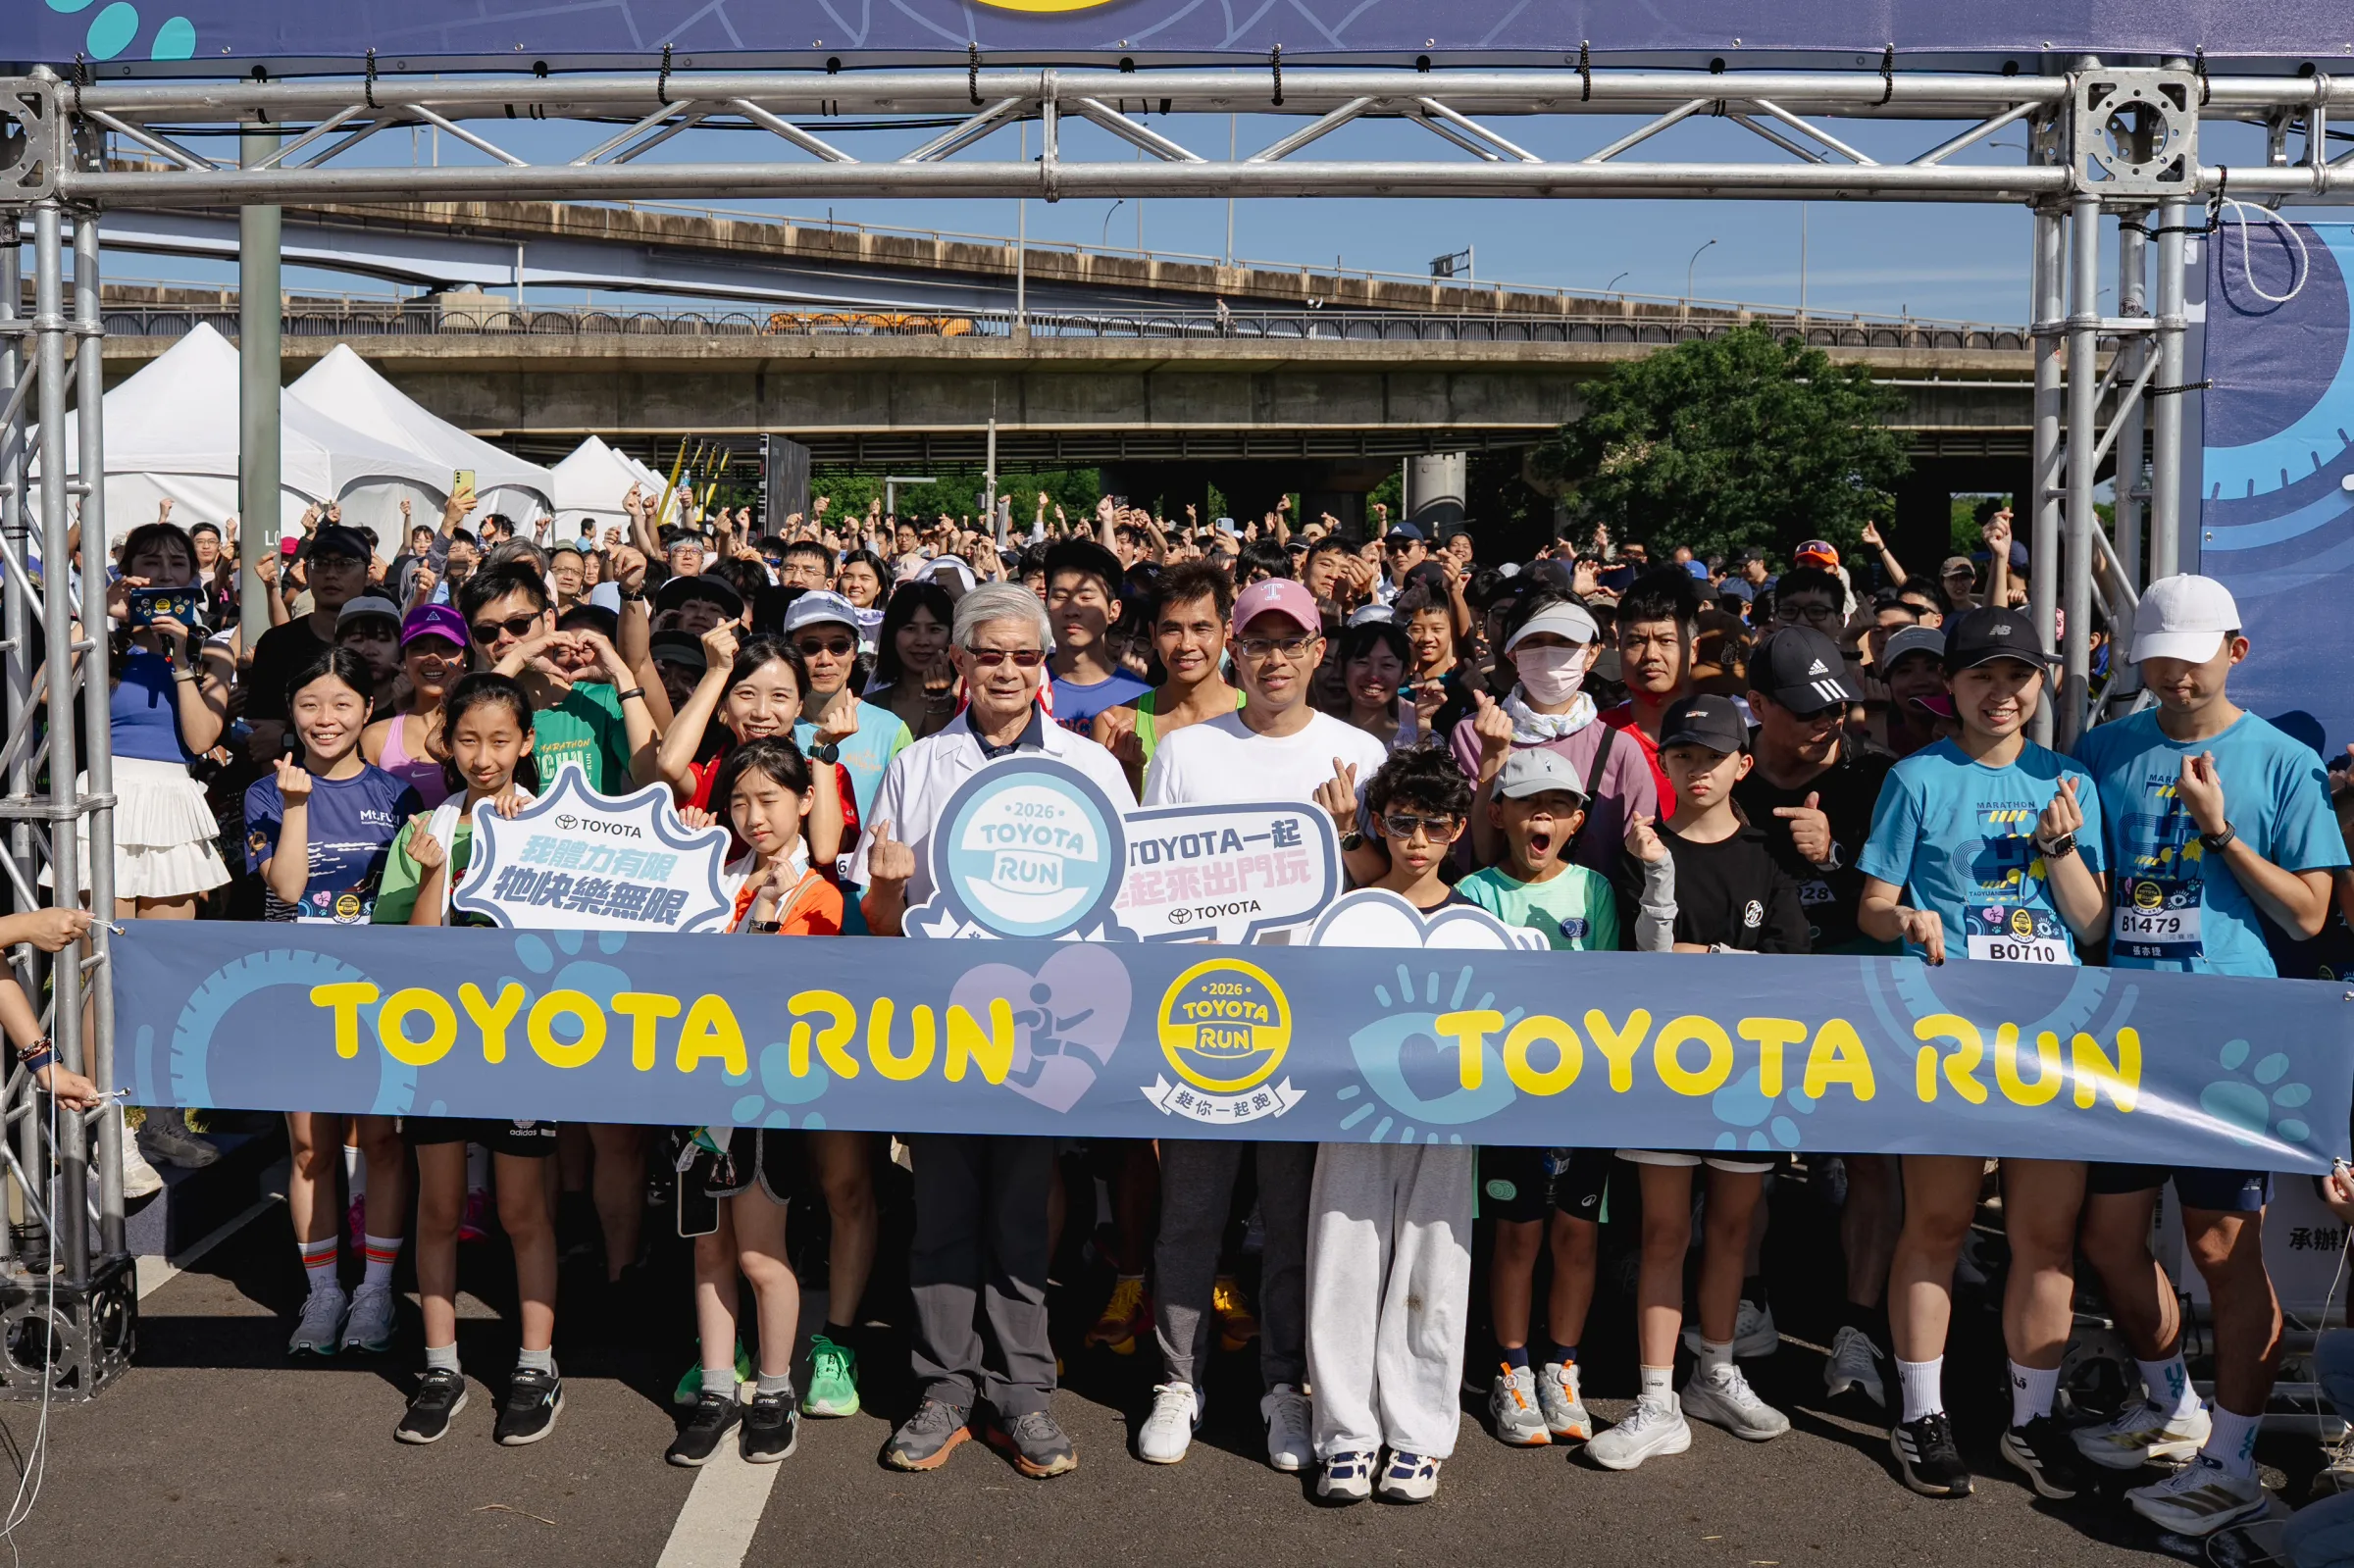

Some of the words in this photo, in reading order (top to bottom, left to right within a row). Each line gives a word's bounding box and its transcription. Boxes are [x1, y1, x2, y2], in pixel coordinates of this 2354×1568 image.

[1261, 582, 1284, 600] T
[1013, 802, 1054, 819] 2026
[1976, 800, 2036, 809] MARATHON
[581, 818, 642, 838] TOYOTA
[980, 823, 1084, 854] TOYOTA
[519, 835, 678, 883] 我體力有限
[998, 857, 1057, 885] RUN
[1115, 848, 1311, 909] 起來出門玩
[492, 865, 690, 926] 牠快樂無限
[1195, 899, 1261, 920] TOYOTA
[2122, 915, 2180, 934] B1479
[1990, 943, 2055, 962] B0710
[1208, 983, 1243, 995] 2026
[1182, 999, 1269, 1023] TOYOTA
[310, 983, 748, 1076] TOYOTA
[788, 990, 1014, 1086] RUN
[1200, 1028, 1250, 1049] RUN
[1435, 1010, 1876, 1101] TOYOTA
[1915, 1013, 2142, 1112] RUN
[1175, 1089, 1272, 1118] 挺你一起跑
